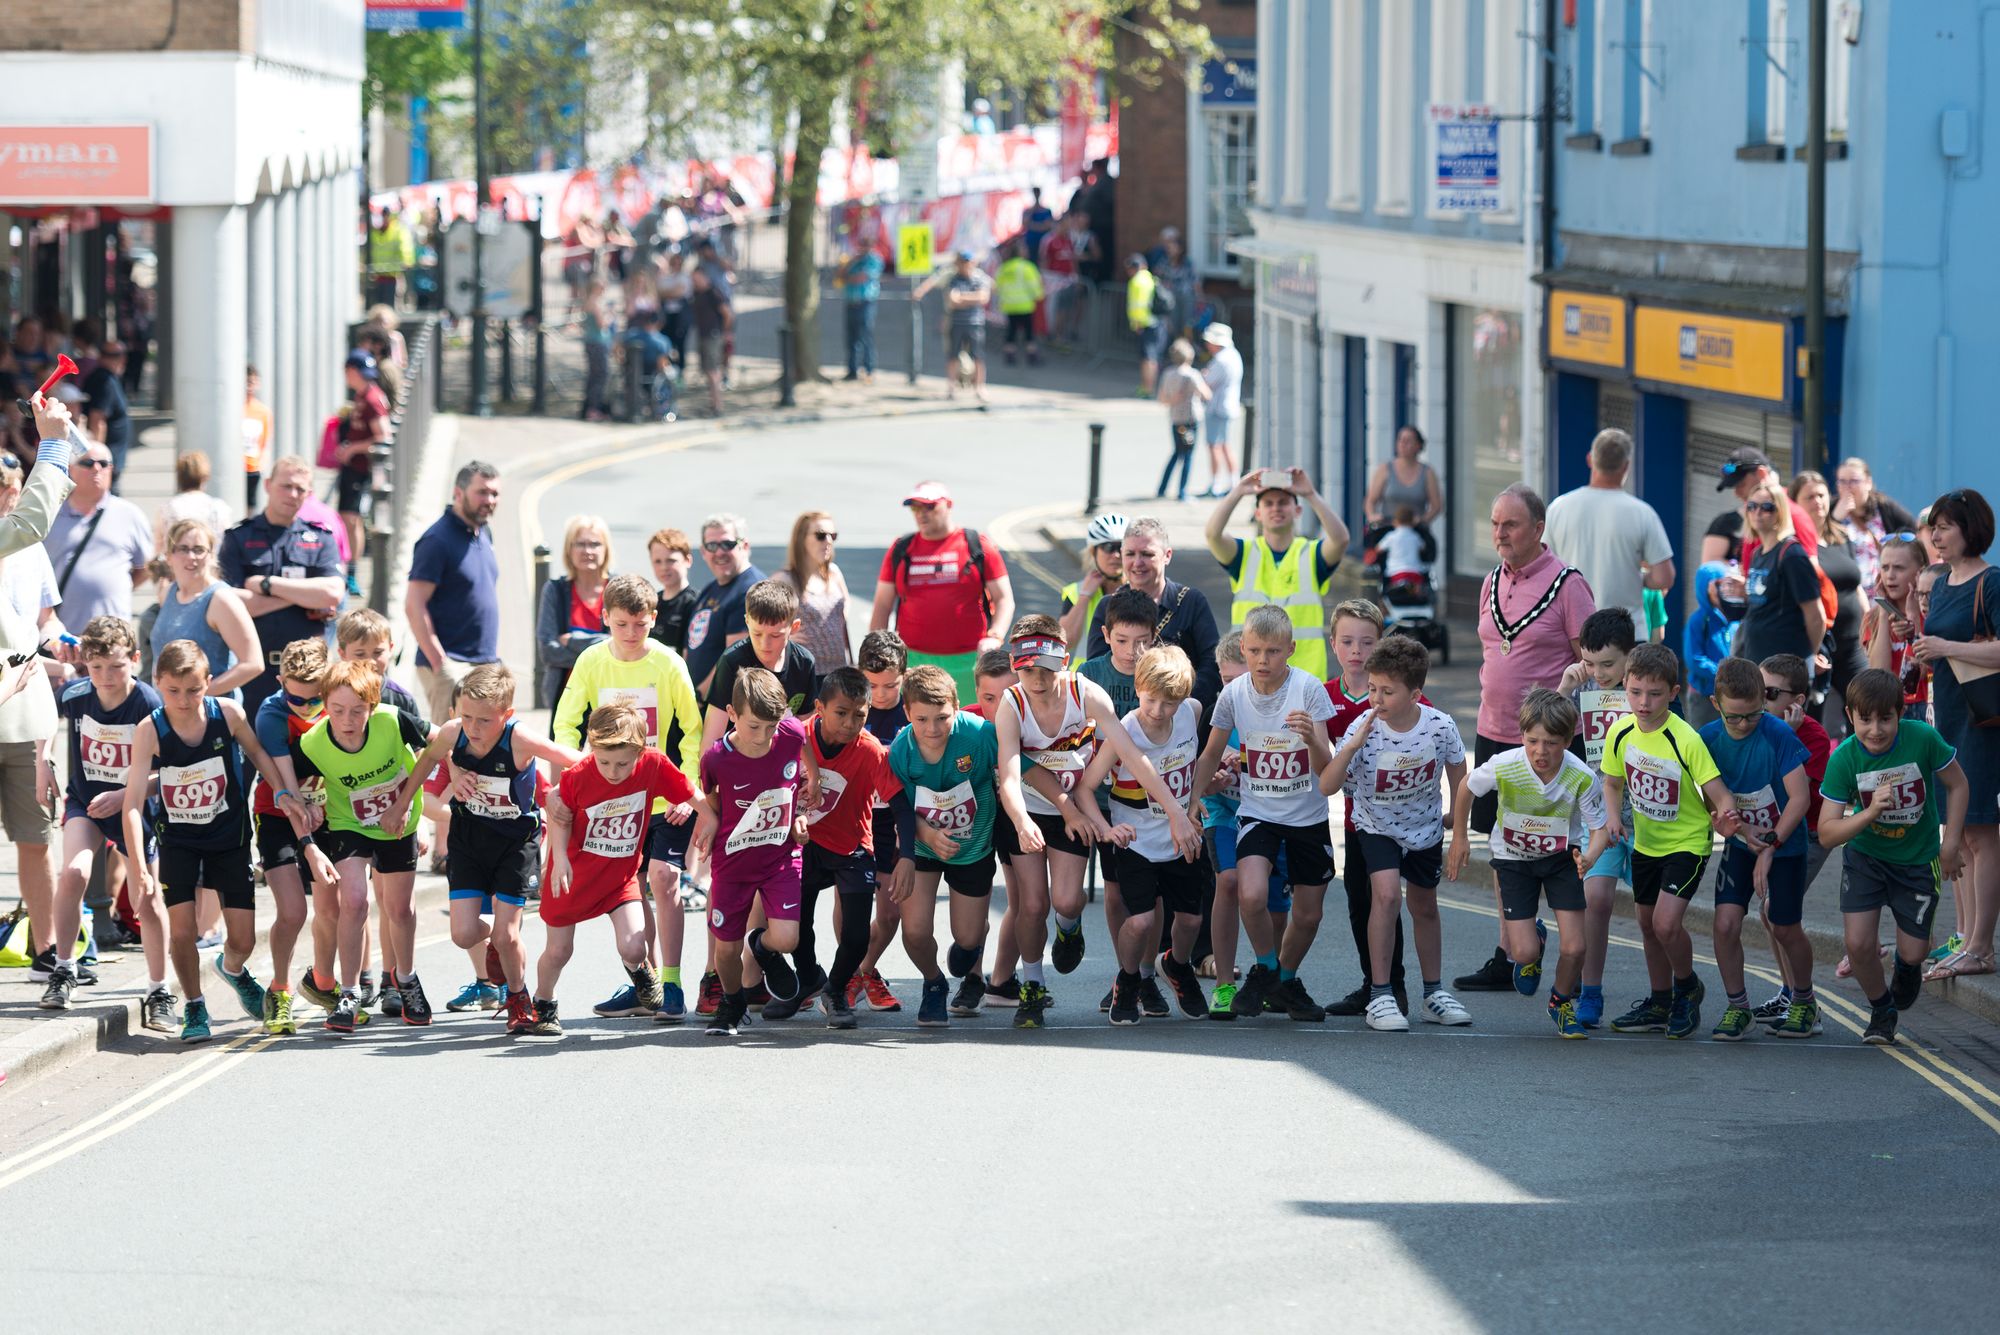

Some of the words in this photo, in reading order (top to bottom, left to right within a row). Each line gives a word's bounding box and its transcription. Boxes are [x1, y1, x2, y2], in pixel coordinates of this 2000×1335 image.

[88, 741, 129, 767] 691
[1256, 752, 1301, 779] 696
[358, 771, 375, 782] RAT
[376, 757, 396, 774] RACE
[1169, 765, 1192, 799] 94
[1384, 765, 1428, 792] 536
[173, 779, 218, 809] 699
[1265, 784, 1270, 792] Y
[1272, 784, 1290, 793] Maer
[1292, 779, 1309, 791] 2018
[1631, 769, 1669, 804] 688
[593, 814, 637, 839] 686
[749, 835, 767, 843] Maer
[599, 842, 604, 850] Y
[605, 843, 623, 853] Maer
[1915, 894, 1931, 925] 7
